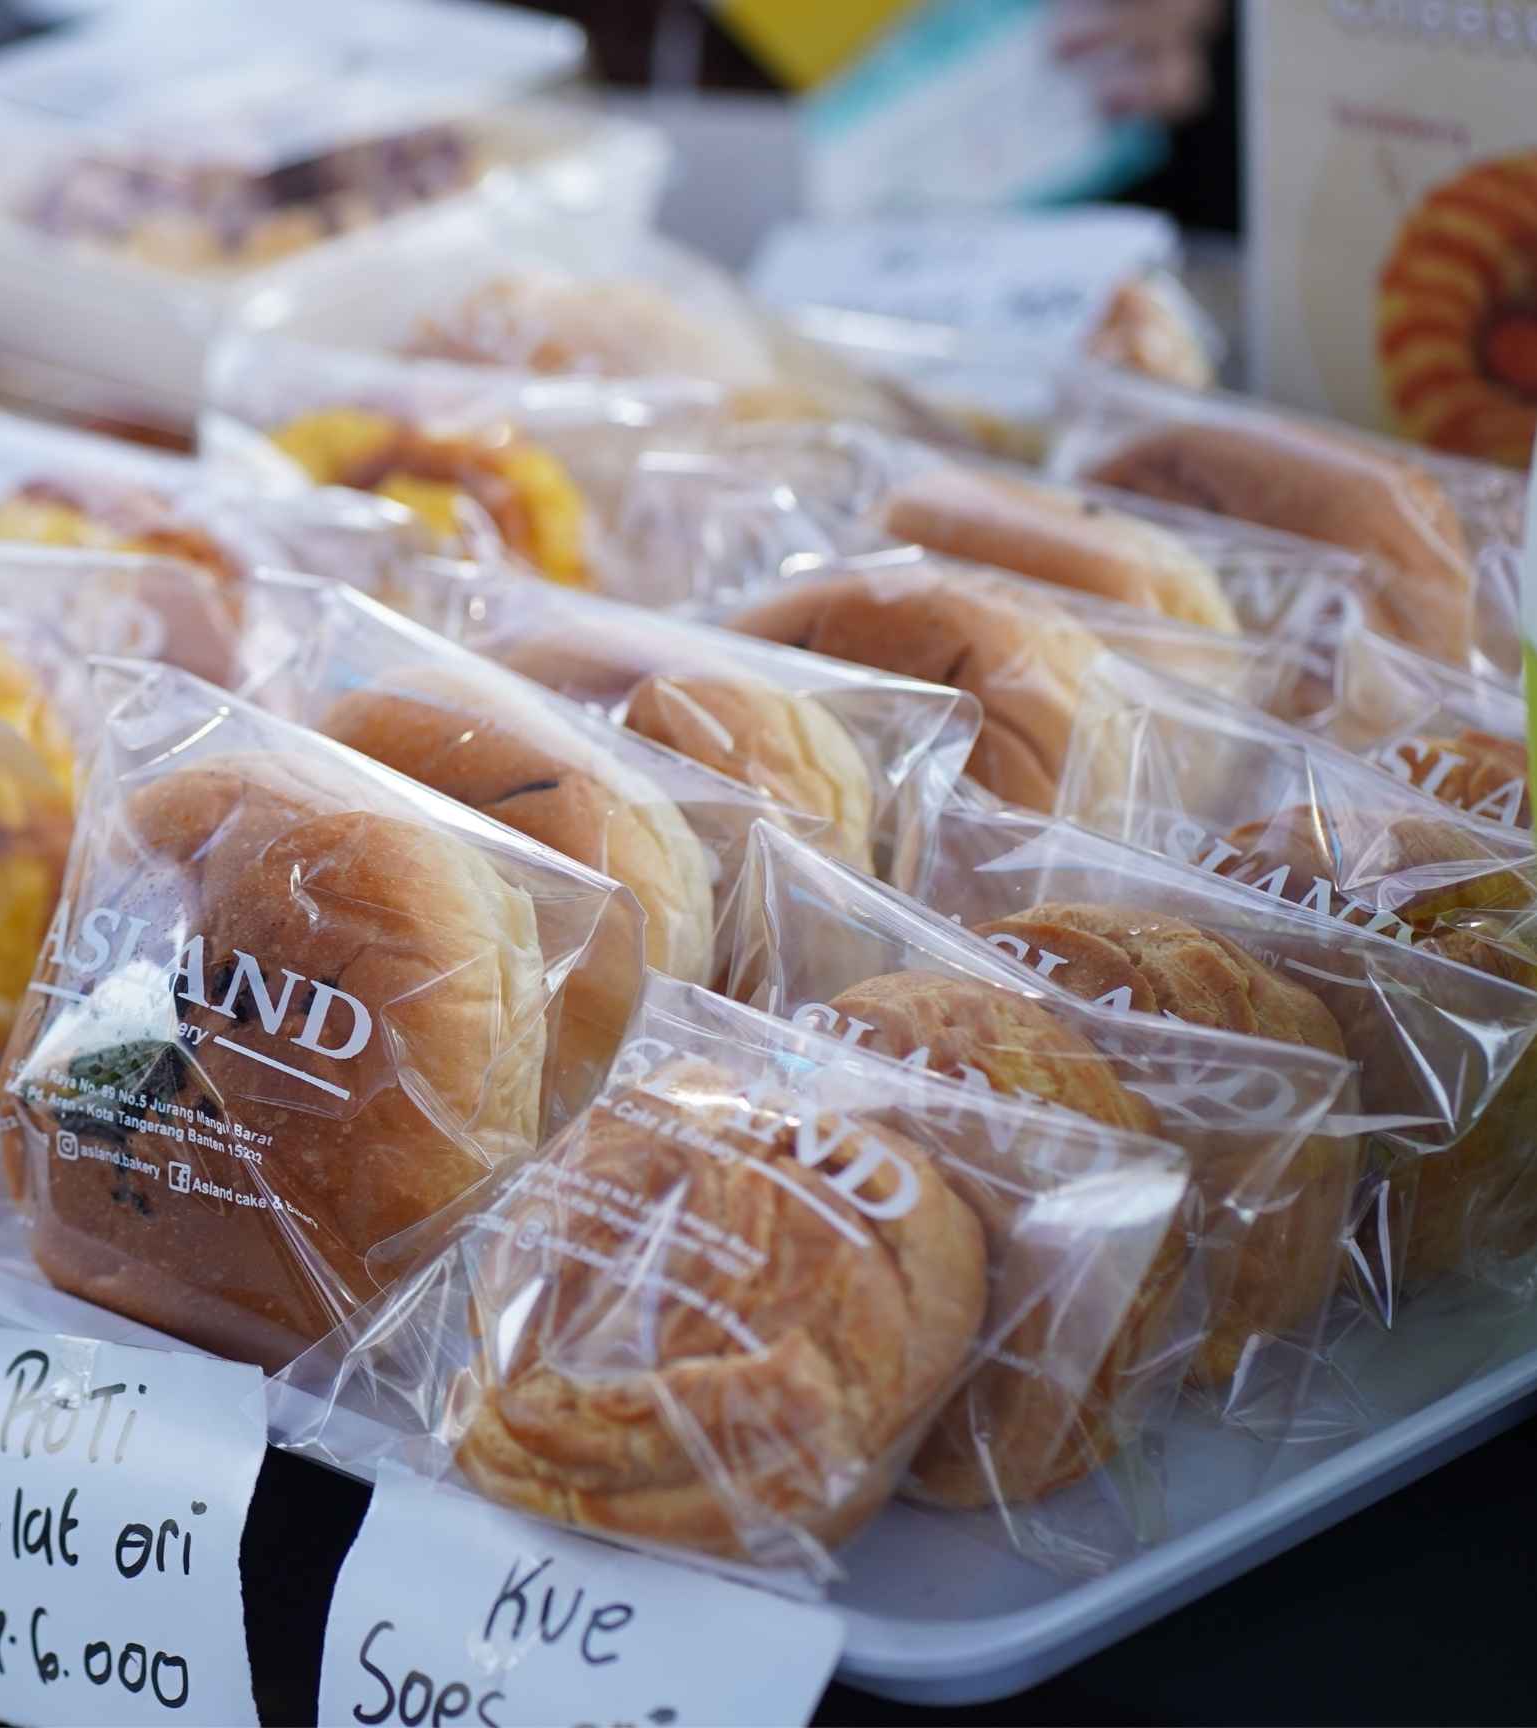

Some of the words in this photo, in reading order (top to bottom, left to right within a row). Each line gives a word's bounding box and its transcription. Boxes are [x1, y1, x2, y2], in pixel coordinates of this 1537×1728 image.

[86, 1103, 114, 1122] Kota
[118, 1111, 184, 1142] Tangerang
[187, 1129, 225, 1153] Banten
[149, 1098, 194, 1123] Jurang
[234, 1123, 274, 1147] Barat
[192, 1177, 233, 1201] Asland
[235, 1191, 267, 1209] cake
